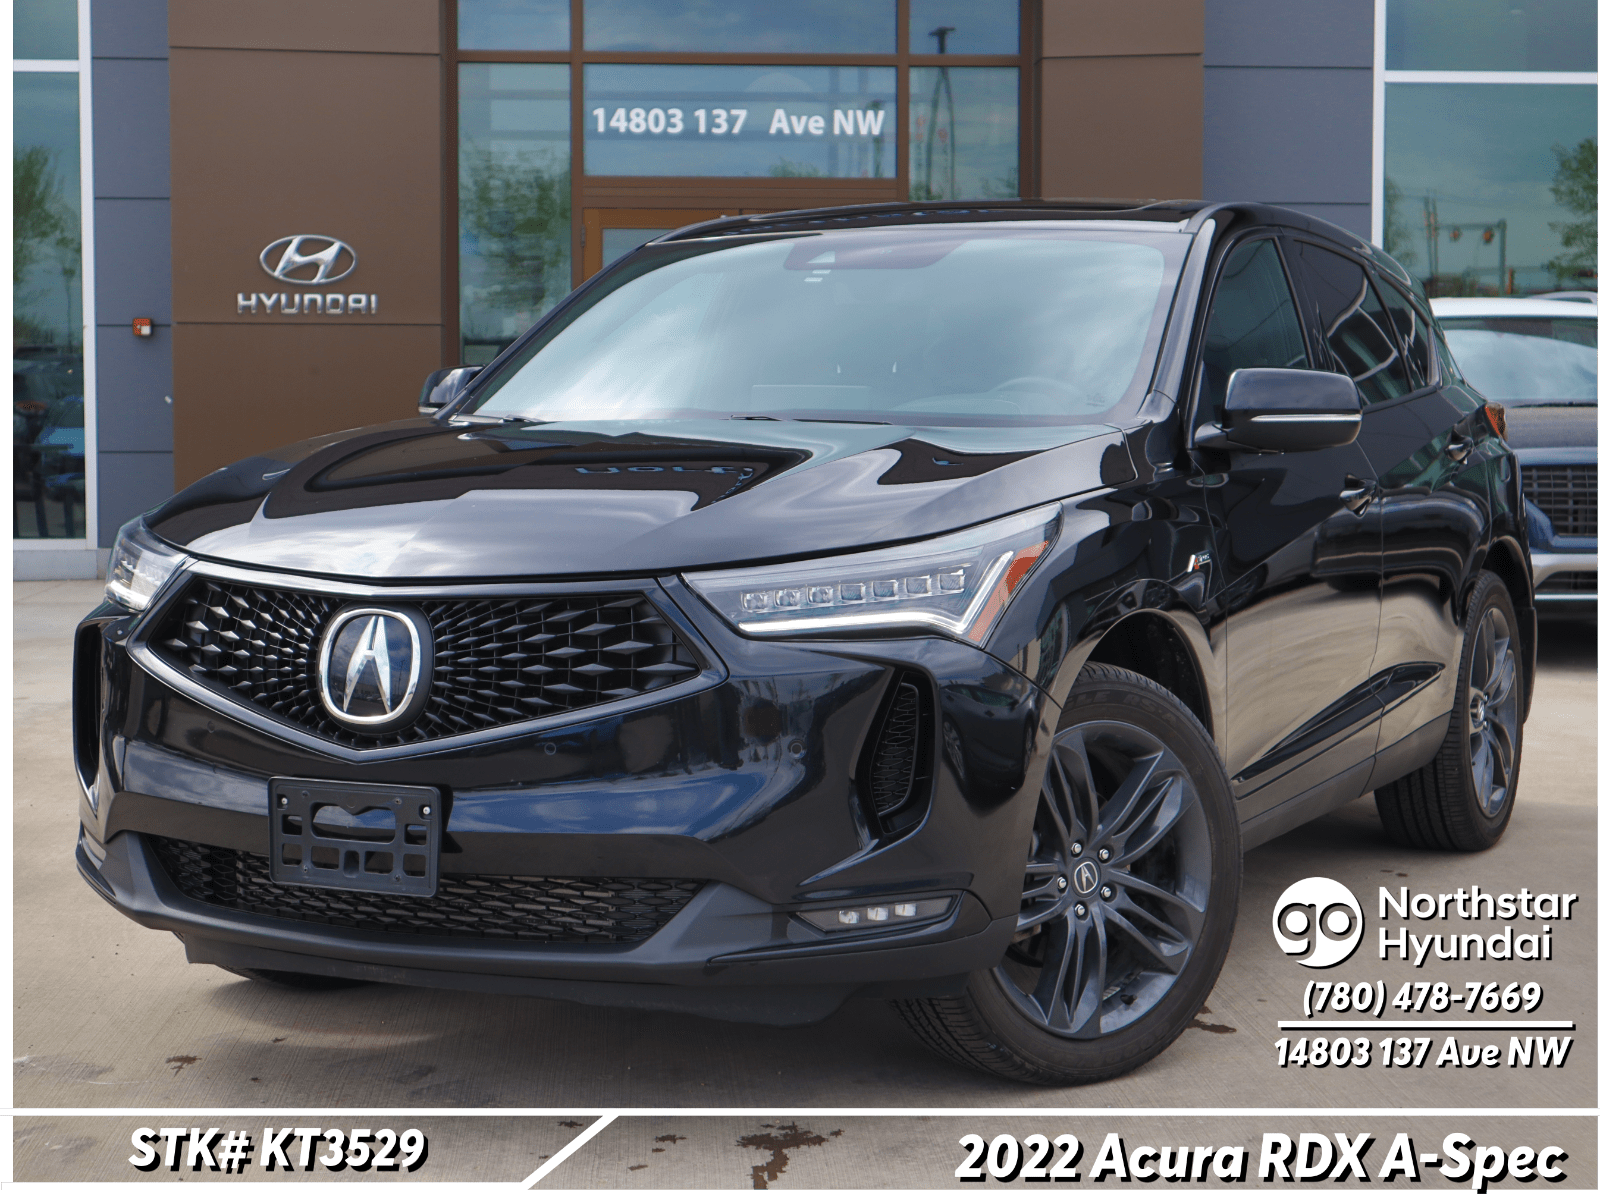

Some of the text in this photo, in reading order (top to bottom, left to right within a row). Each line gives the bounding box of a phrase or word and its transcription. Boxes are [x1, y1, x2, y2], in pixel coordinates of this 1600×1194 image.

[592, 107, 885, 135] 14803 137 Ave NW
[236, 292, 378, 315] HYUNDAI
